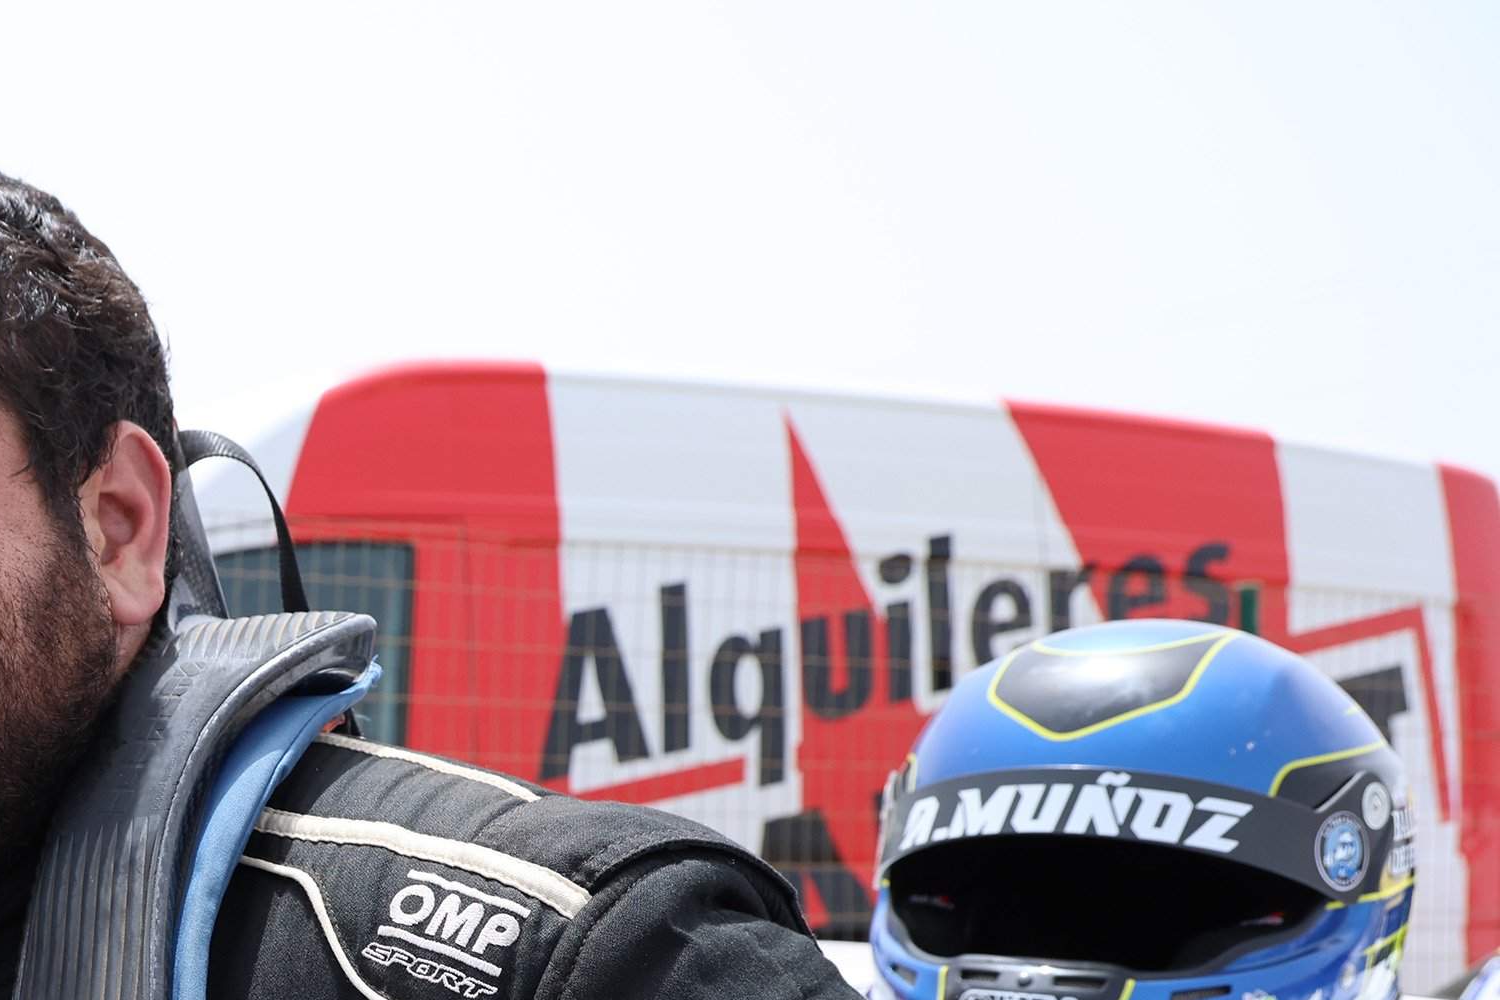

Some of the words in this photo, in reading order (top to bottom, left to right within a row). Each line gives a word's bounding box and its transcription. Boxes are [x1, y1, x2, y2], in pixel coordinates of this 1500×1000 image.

[537, 534, 1233, 789] Alquileres
[389, 883, 521, 955] OMP
[361, 941, 499, 999] SPORT
